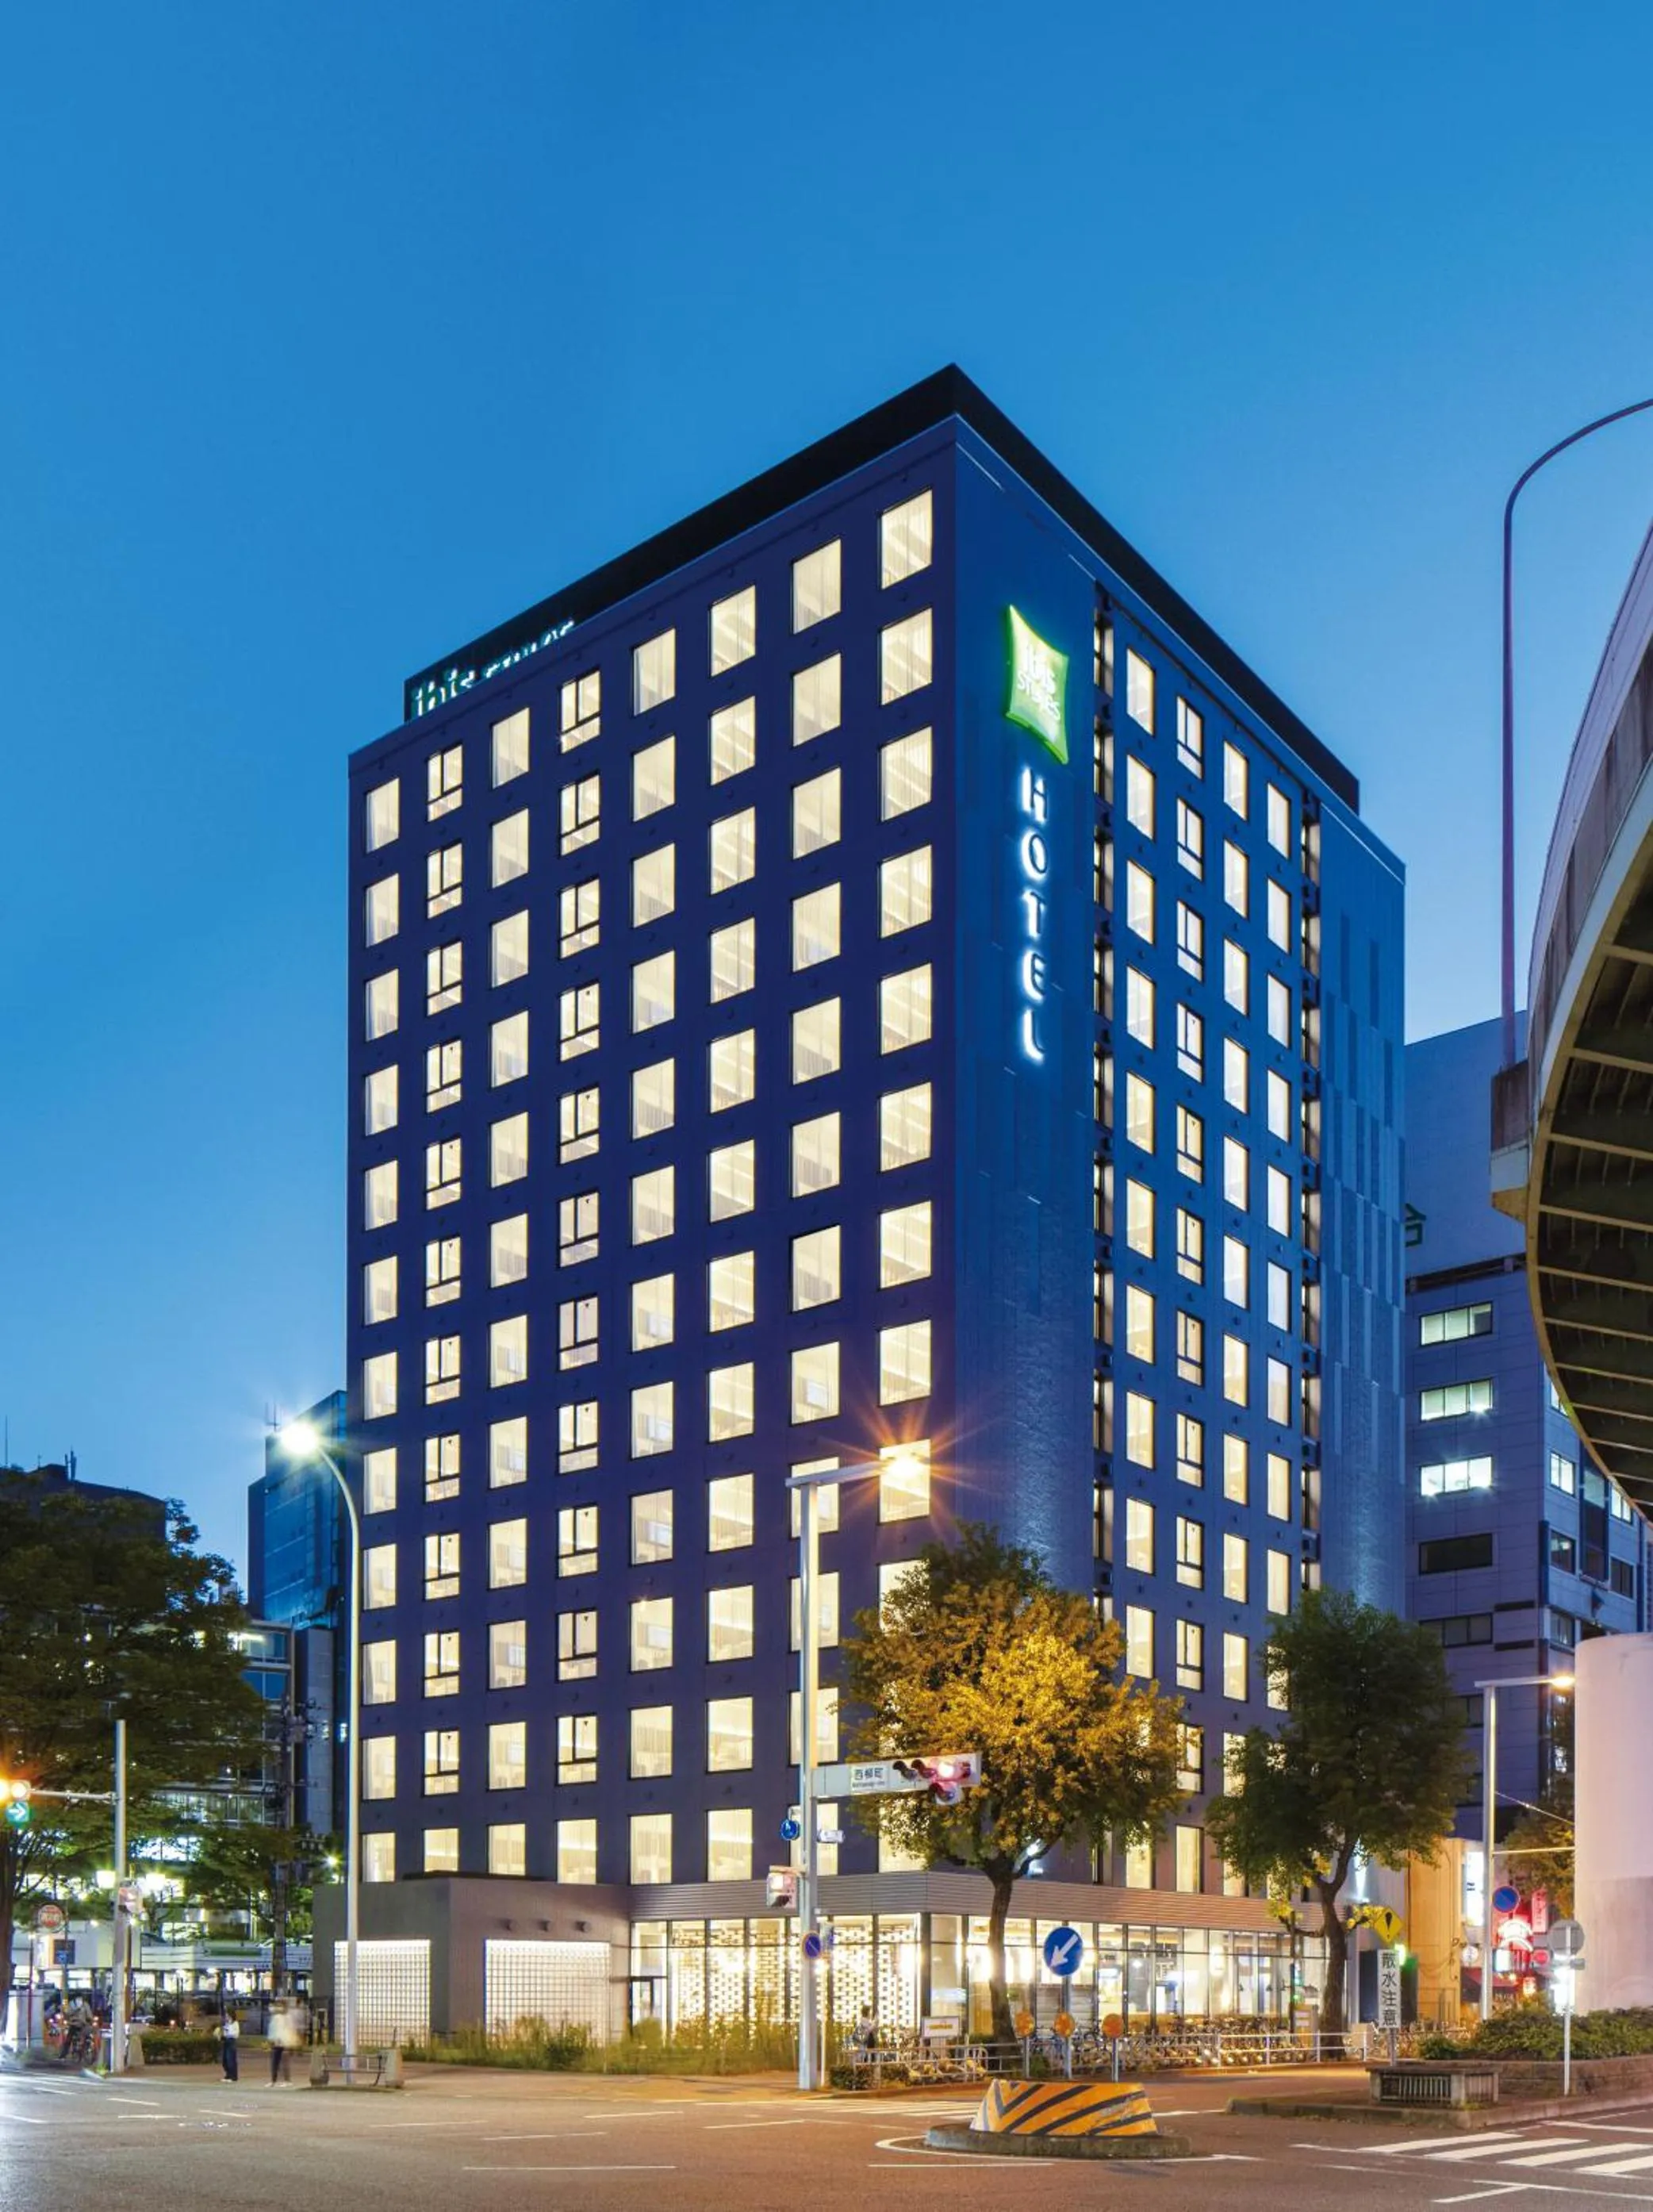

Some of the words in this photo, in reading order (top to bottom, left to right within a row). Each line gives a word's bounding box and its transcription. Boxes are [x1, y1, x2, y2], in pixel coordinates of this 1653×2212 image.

[1021, 766, 1048, 1062] HOTEL
[1382, 1952, 1397, 2026] 散水注意
